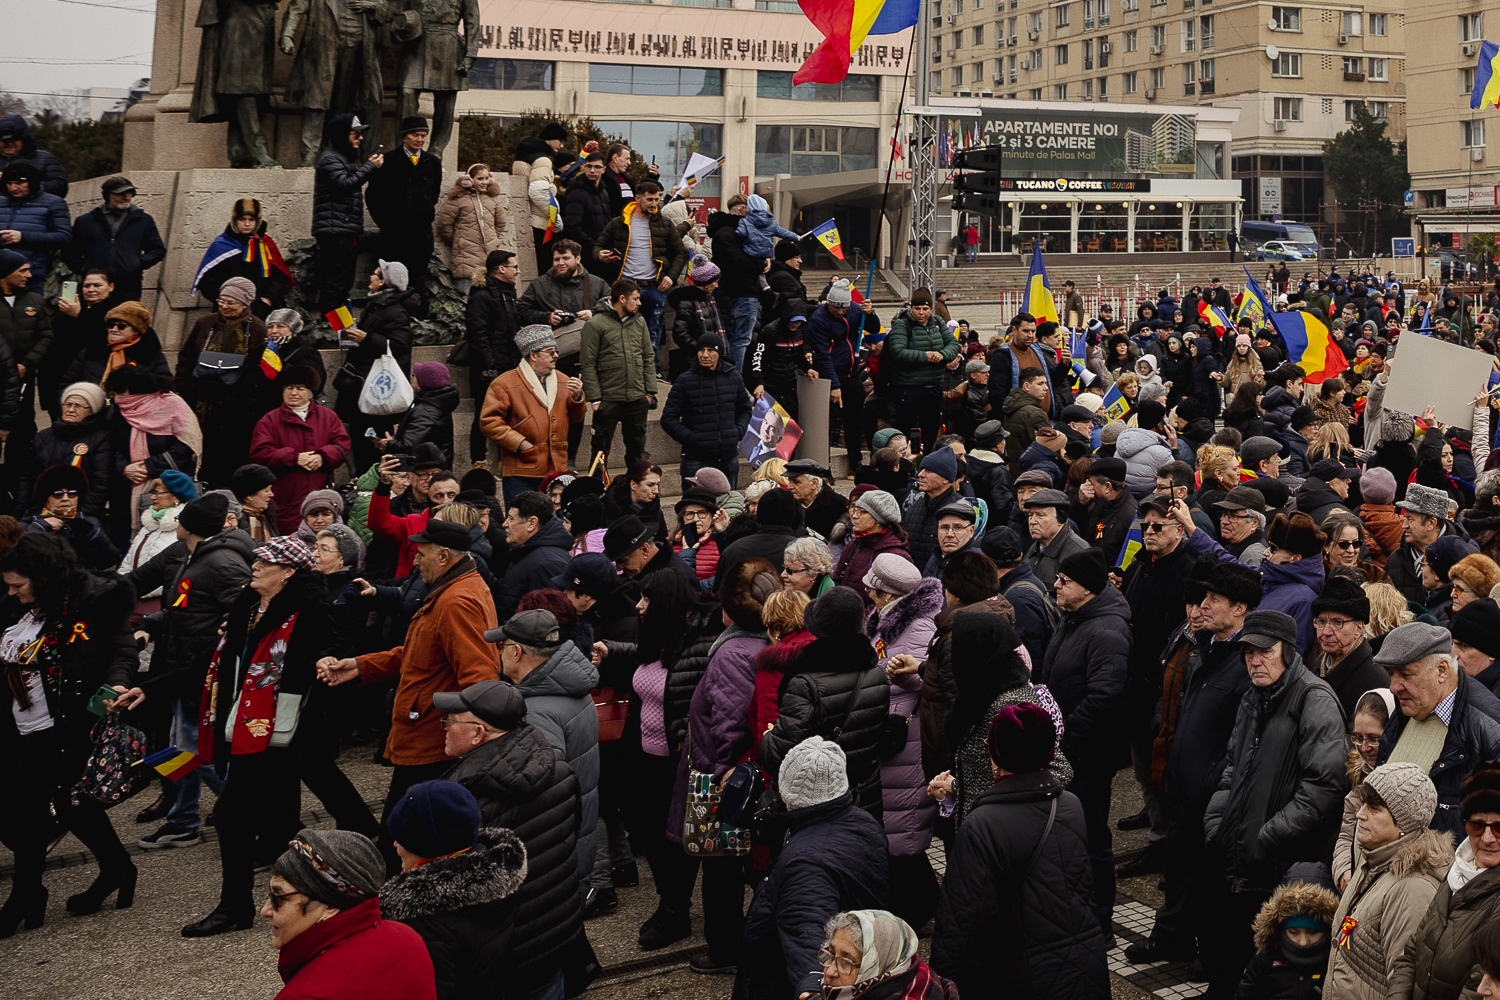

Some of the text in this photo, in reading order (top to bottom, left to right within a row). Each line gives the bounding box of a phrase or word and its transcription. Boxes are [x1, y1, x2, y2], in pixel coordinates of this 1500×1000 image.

[984, 120, 1118, 136] APARTAMENTE NOI
[998, 135, 1006, 147] 2
[1009, 135, 1021, 149] și
[1024, 135, 1033, 148] 3
[1036, 136, 1096, 149] CAMERE
[1002, 150, 1096, 160] minute de Palas Mall
[1016, 181, 1102, 189] TUCANO COFFEE
